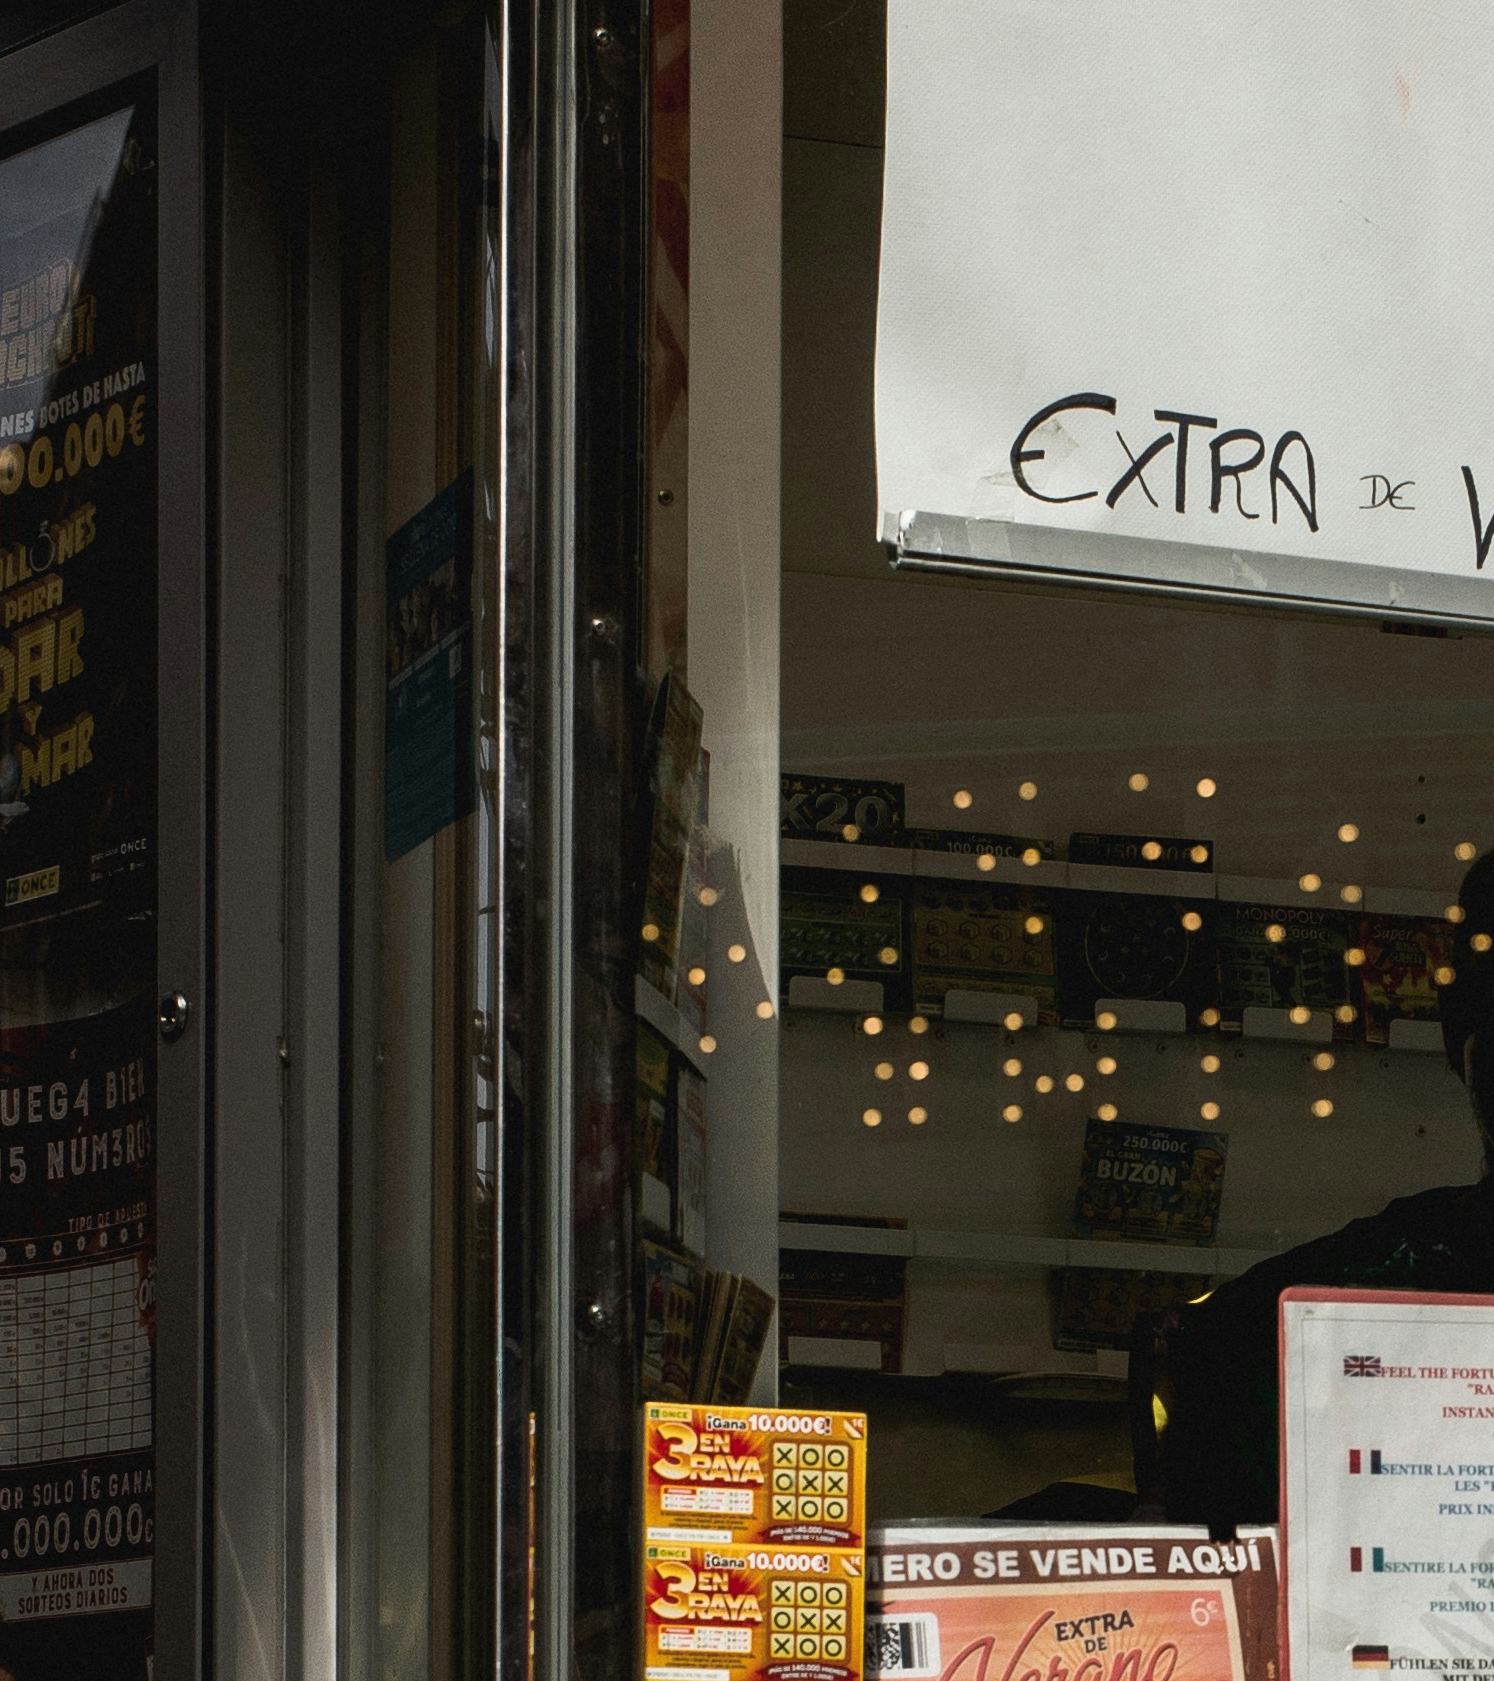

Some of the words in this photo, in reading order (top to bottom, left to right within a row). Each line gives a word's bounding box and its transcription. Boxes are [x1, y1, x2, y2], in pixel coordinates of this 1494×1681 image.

[39, 390, 80, 430] BOTES
[103, 361, 146, 400] HASTA
[1008, 390, 1317, 534] EXTRA
[1359, 474, 1418, 511] DE
[21, 873, 56, 894] ONCE
[1381, 1367, 1416, 1379] FEEL
[1419, 1367, 1449, 1379] THE
[653, 1422, 698, 1480] 3
[700, 1433, 730, 1453] EN
[690, 1456, 765, 1483] RAYA
[33, 1479, 74, 1508] SOLO
[108, 1469, 154, 1497] GANA
[1439, 1504, 1473, 1515] PRIX
[973, 1549, 1020, 1578] SE
[1029, 1547, 1158, 1577] VENDE
[1168, 1540, 1262, 1575] AQUÍ
[43, 1571, 84, 1592] AHORA
[89, 1568, 115, 1587] DOS
[651, 1560, 696, 1622] 3
[699, 1574, 729, 1593] EN
[19, 1591, 73, 1615] SORTEOS
[76, 1587, 128, 1609] DIARIOS
[689, 1594, 763, 1622] RAYA
[1429, 1601, 1486, 1613] PREMIO
[1055, 1610, 1134, 1642] EXTRA
[1085, 1637, 1108, 1654] DE
[1389, 1656, 1449, 1670] FÜHLEN
[1451, 1659, 1475, 1670] SIE
